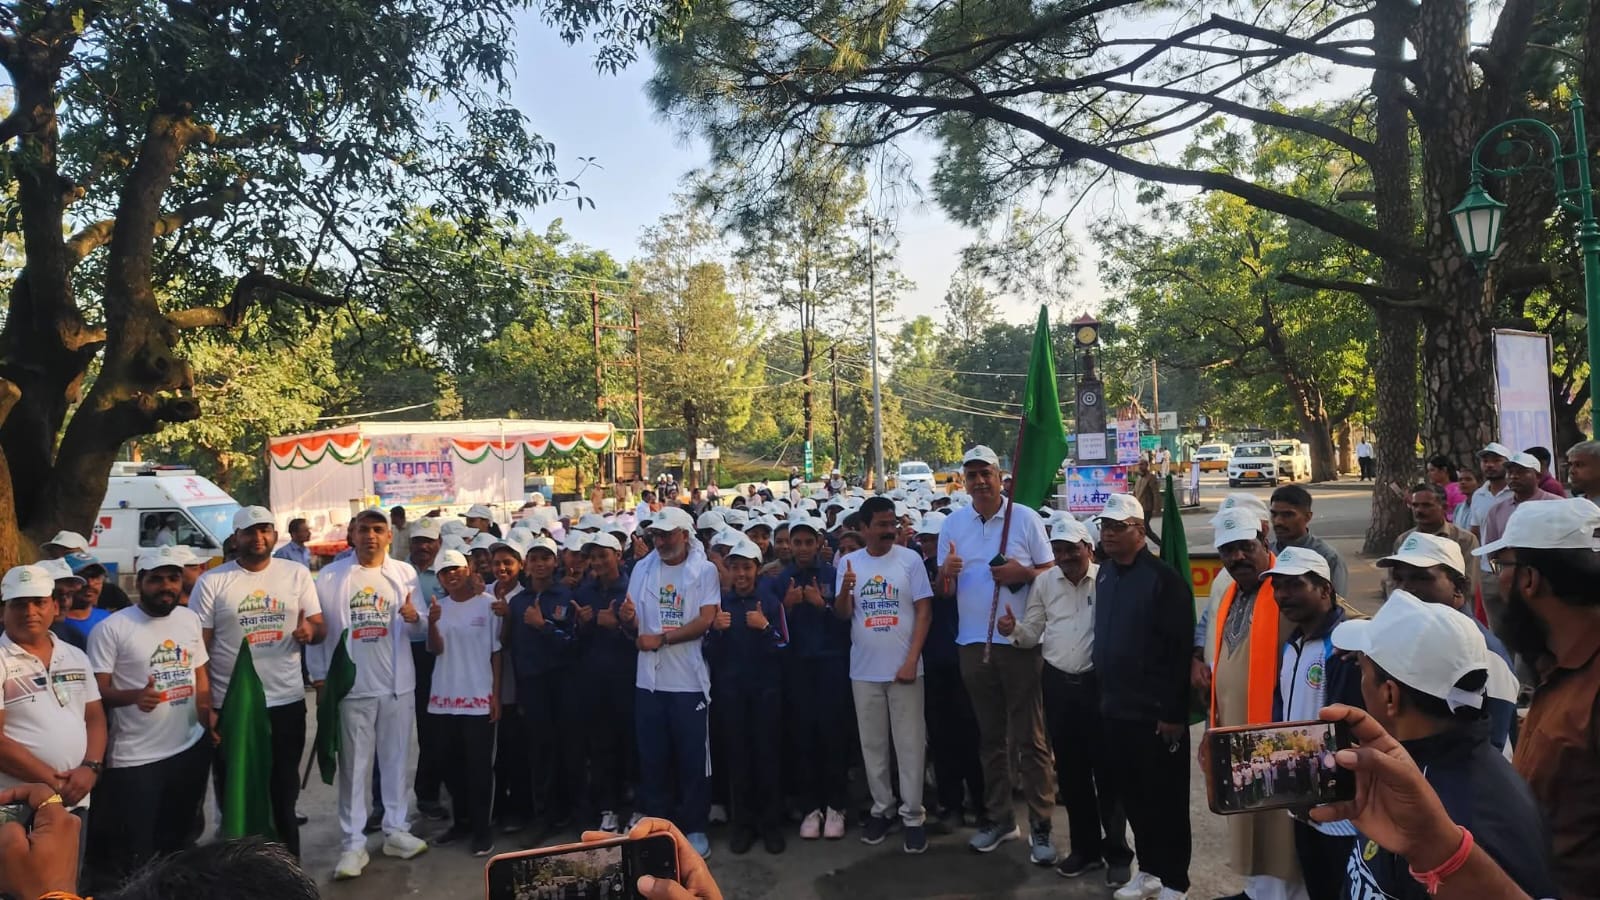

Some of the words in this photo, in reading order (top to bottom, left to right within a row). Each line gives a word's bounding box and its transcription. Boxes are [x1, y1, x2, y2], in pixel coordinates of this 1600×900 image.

[1090, 489, 1111, 503] मैरा
[861, 599, 876, 610] सेवा
[877, 599, 899, 609] संकल्प
[239, 615, 258, 626] सेवा
